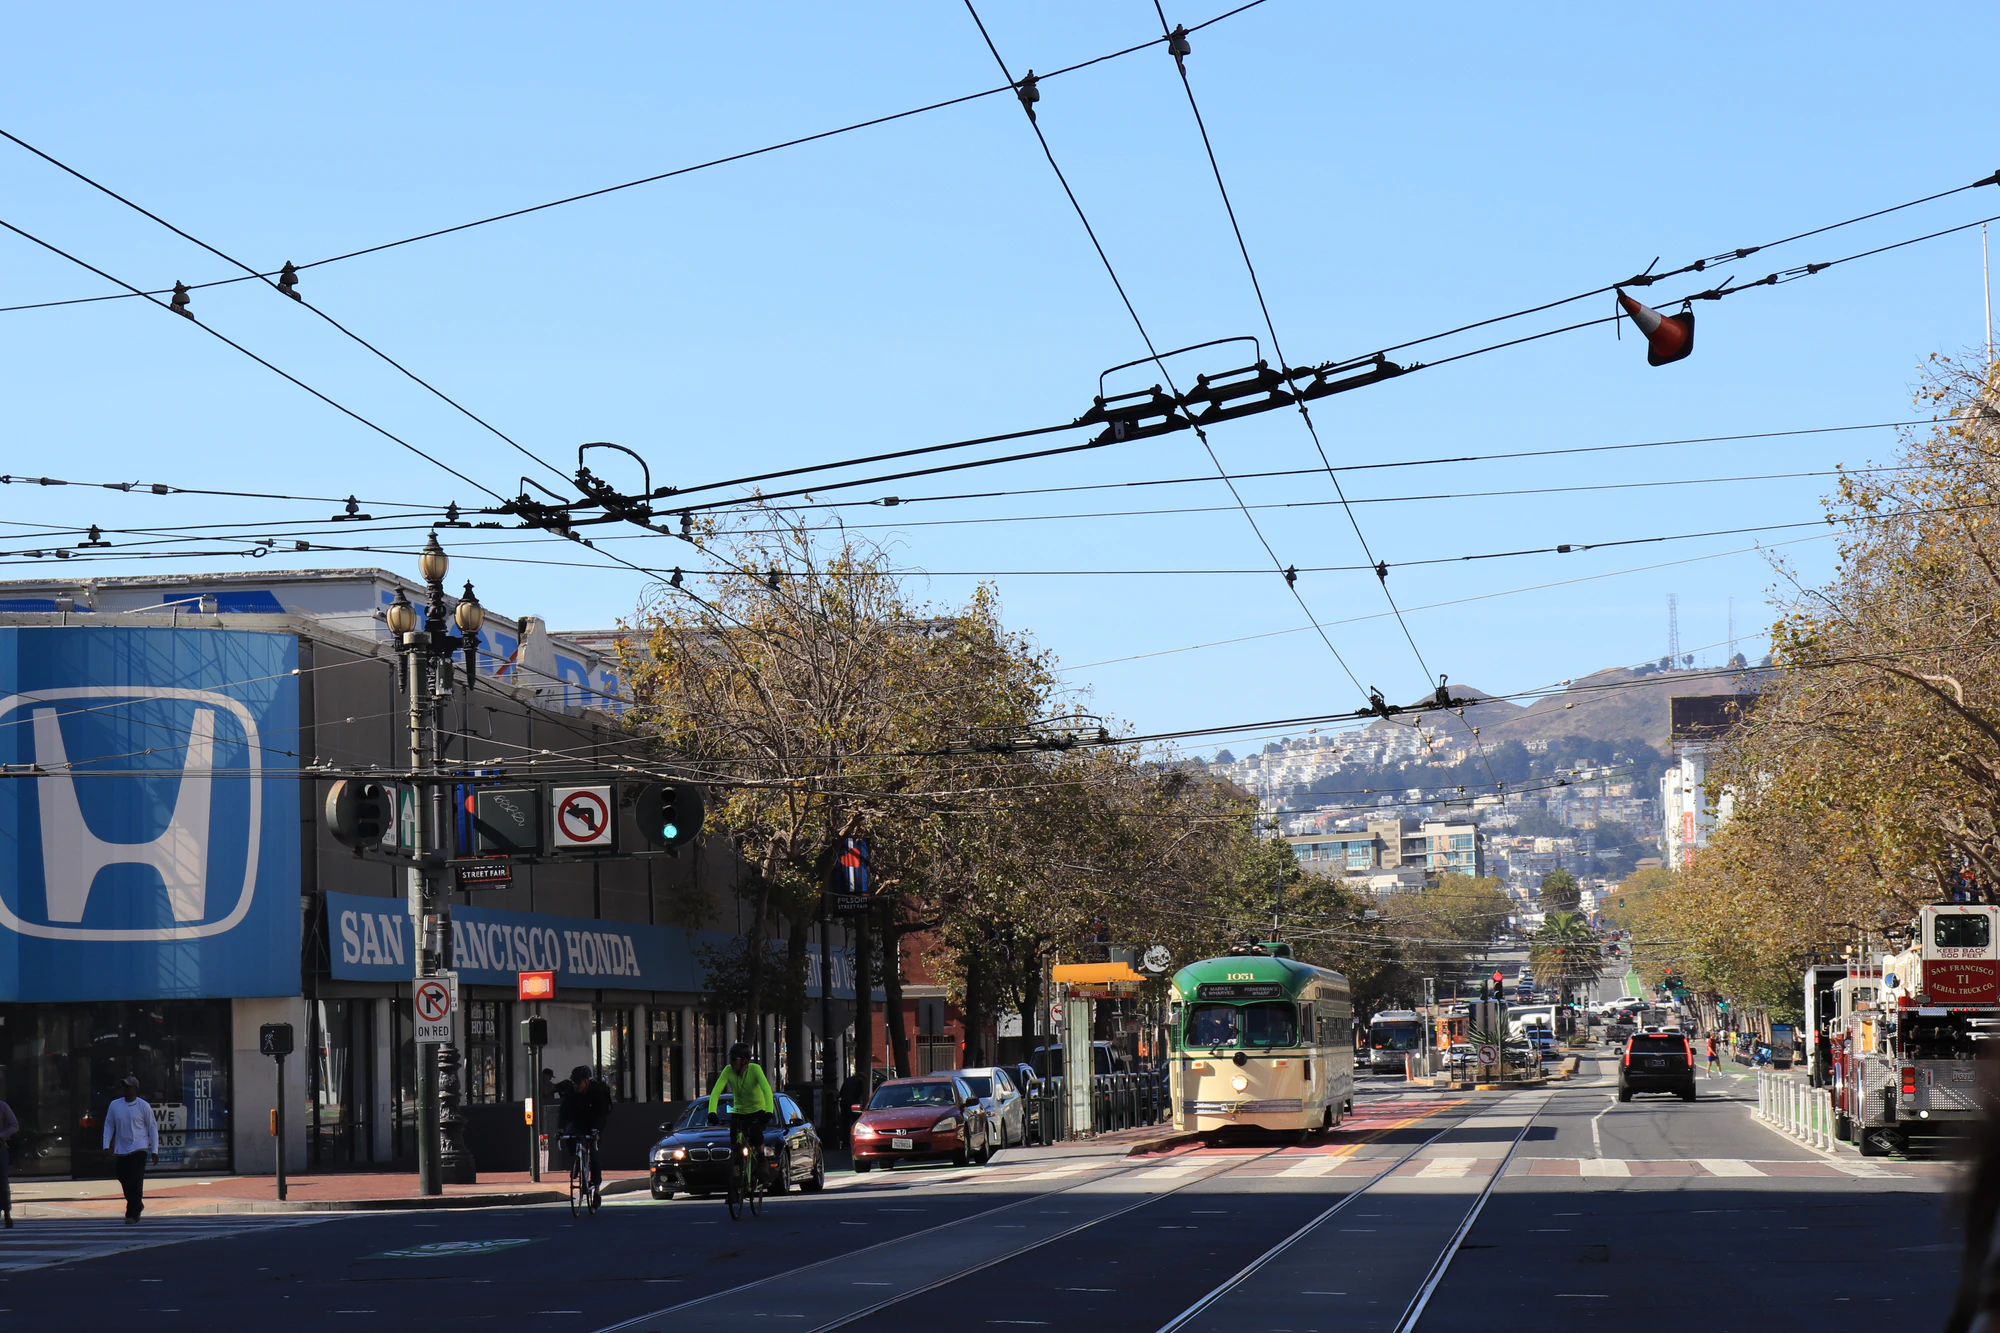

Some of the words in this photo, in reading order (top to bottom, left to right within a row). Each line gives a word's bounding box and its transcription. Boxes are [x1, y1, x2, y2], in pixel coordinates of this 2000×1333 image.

[462, 870, 488, 879] STREET
[489, 869, 506, 877] FAIR
[340, 909, 405, 966] SAN
[411, 915, 562, 973] ANCISCO
[563, 930, 641, 977] HONDA
[1931, 966, 1947, 976] SAN
[1949, 964, 1994, 976] FRANCISCO
[1226, 973, 1255, 981] 1051
[1956, 974, 1969, 984] T1
[1931, 982, 1957, 994] AERIAL
[418, 1026, 430, 1037] ON
[432, 1025, 449, 1037] RED
[194, 1078, 213, 1098] GET
[152, 1109, 175, 1122] WE
[194, 1099, 214, 1140] BIG
[159, 1123, 177, 1131] UY
[158, 1134, 183, 1147] ARS
